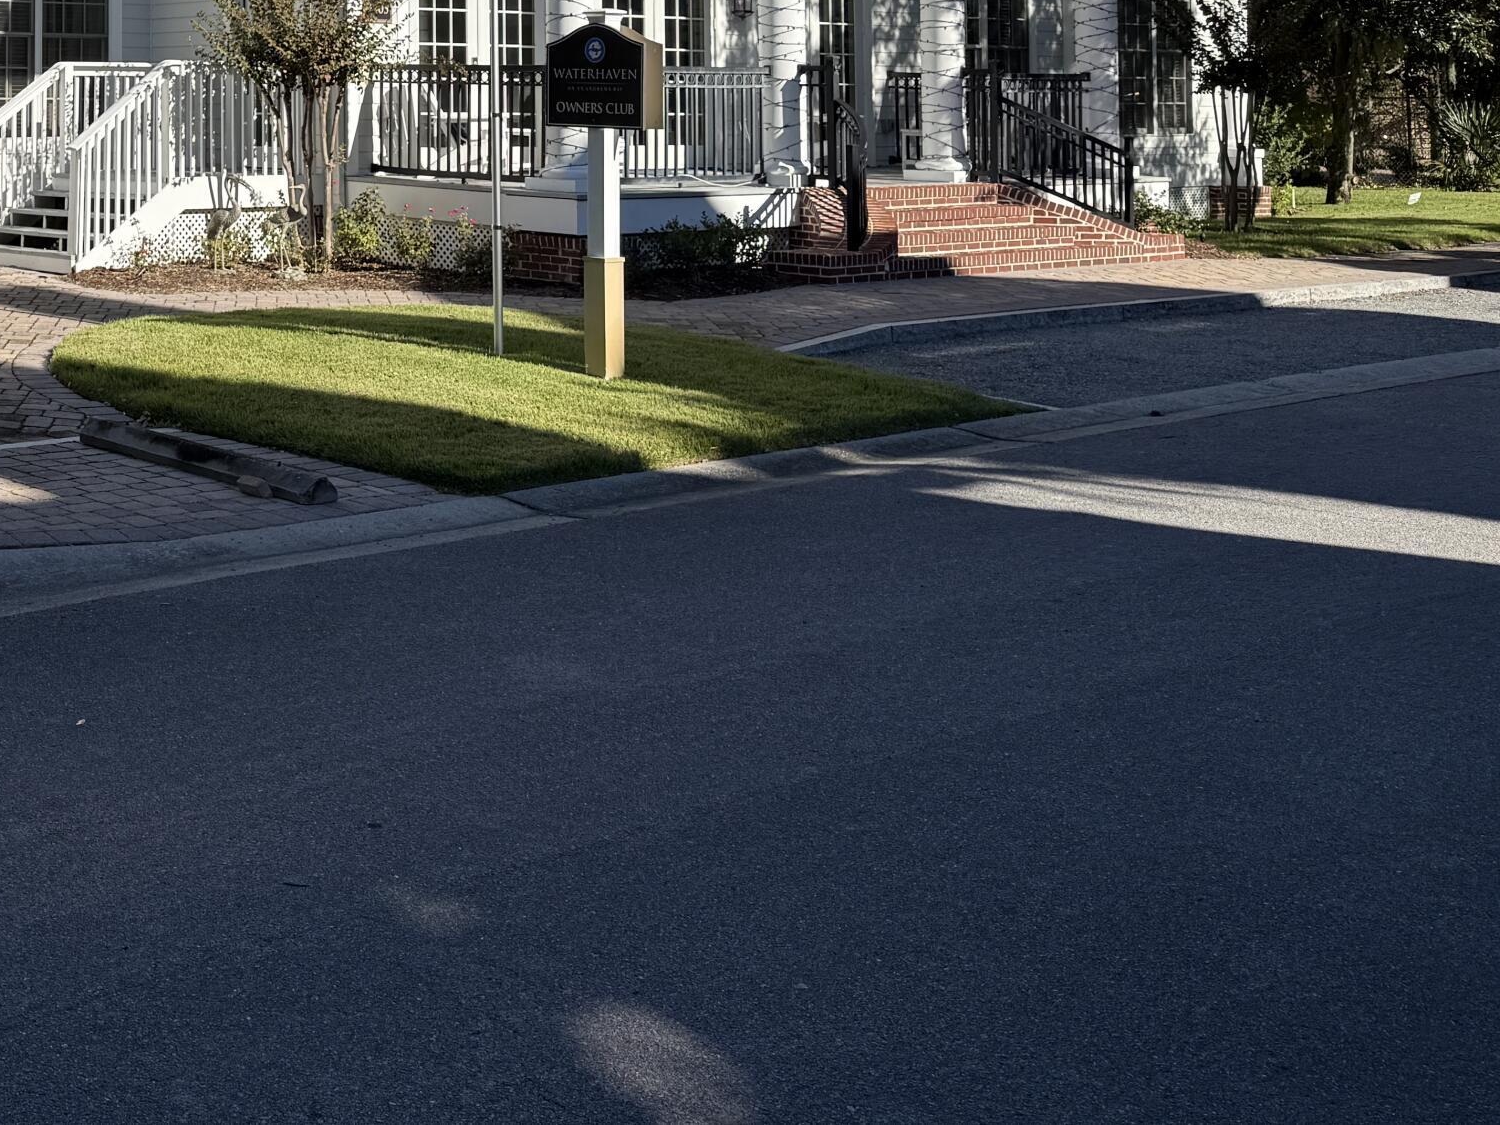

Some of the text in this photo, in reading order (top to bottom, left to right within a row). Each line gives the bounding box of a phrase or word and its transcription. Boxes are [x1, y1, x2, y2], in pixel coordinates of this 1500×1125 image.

[553, 67, 637, 80] WATERHAVEN
[556, 101, 635, 115] OWNERS CLUB
